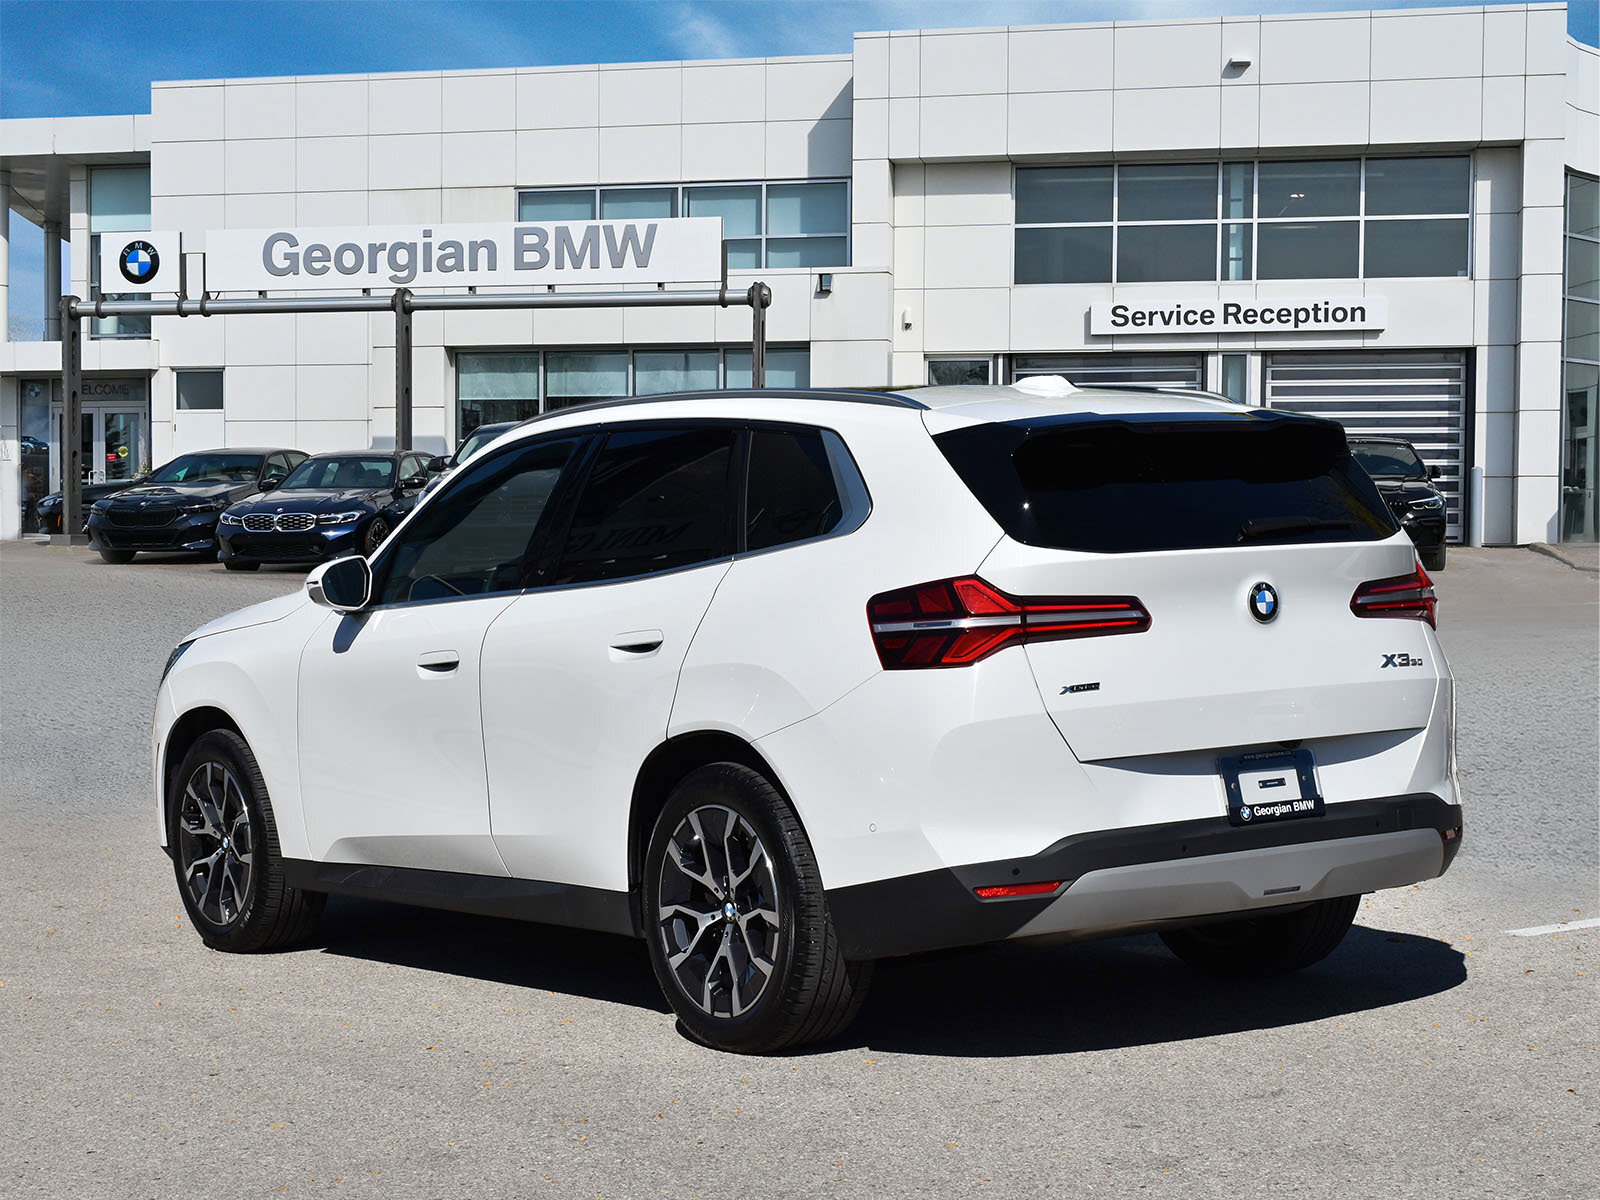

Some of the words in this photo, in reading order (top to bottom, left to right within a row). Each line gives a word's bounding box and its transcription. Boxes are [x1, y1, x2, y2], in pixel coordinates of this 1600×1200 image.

[262, 229, 498, 284] Georgian
[513, 223, 659, 271] BMW
[1110, 304, 1216, 328] Service
[1223, 301, 1367, 328] Reception
[81, 384, 129, 395] ELCOME
[1253, 804, 1293, 817] Georgian
[1293, 800, 1315, 812] BMW
